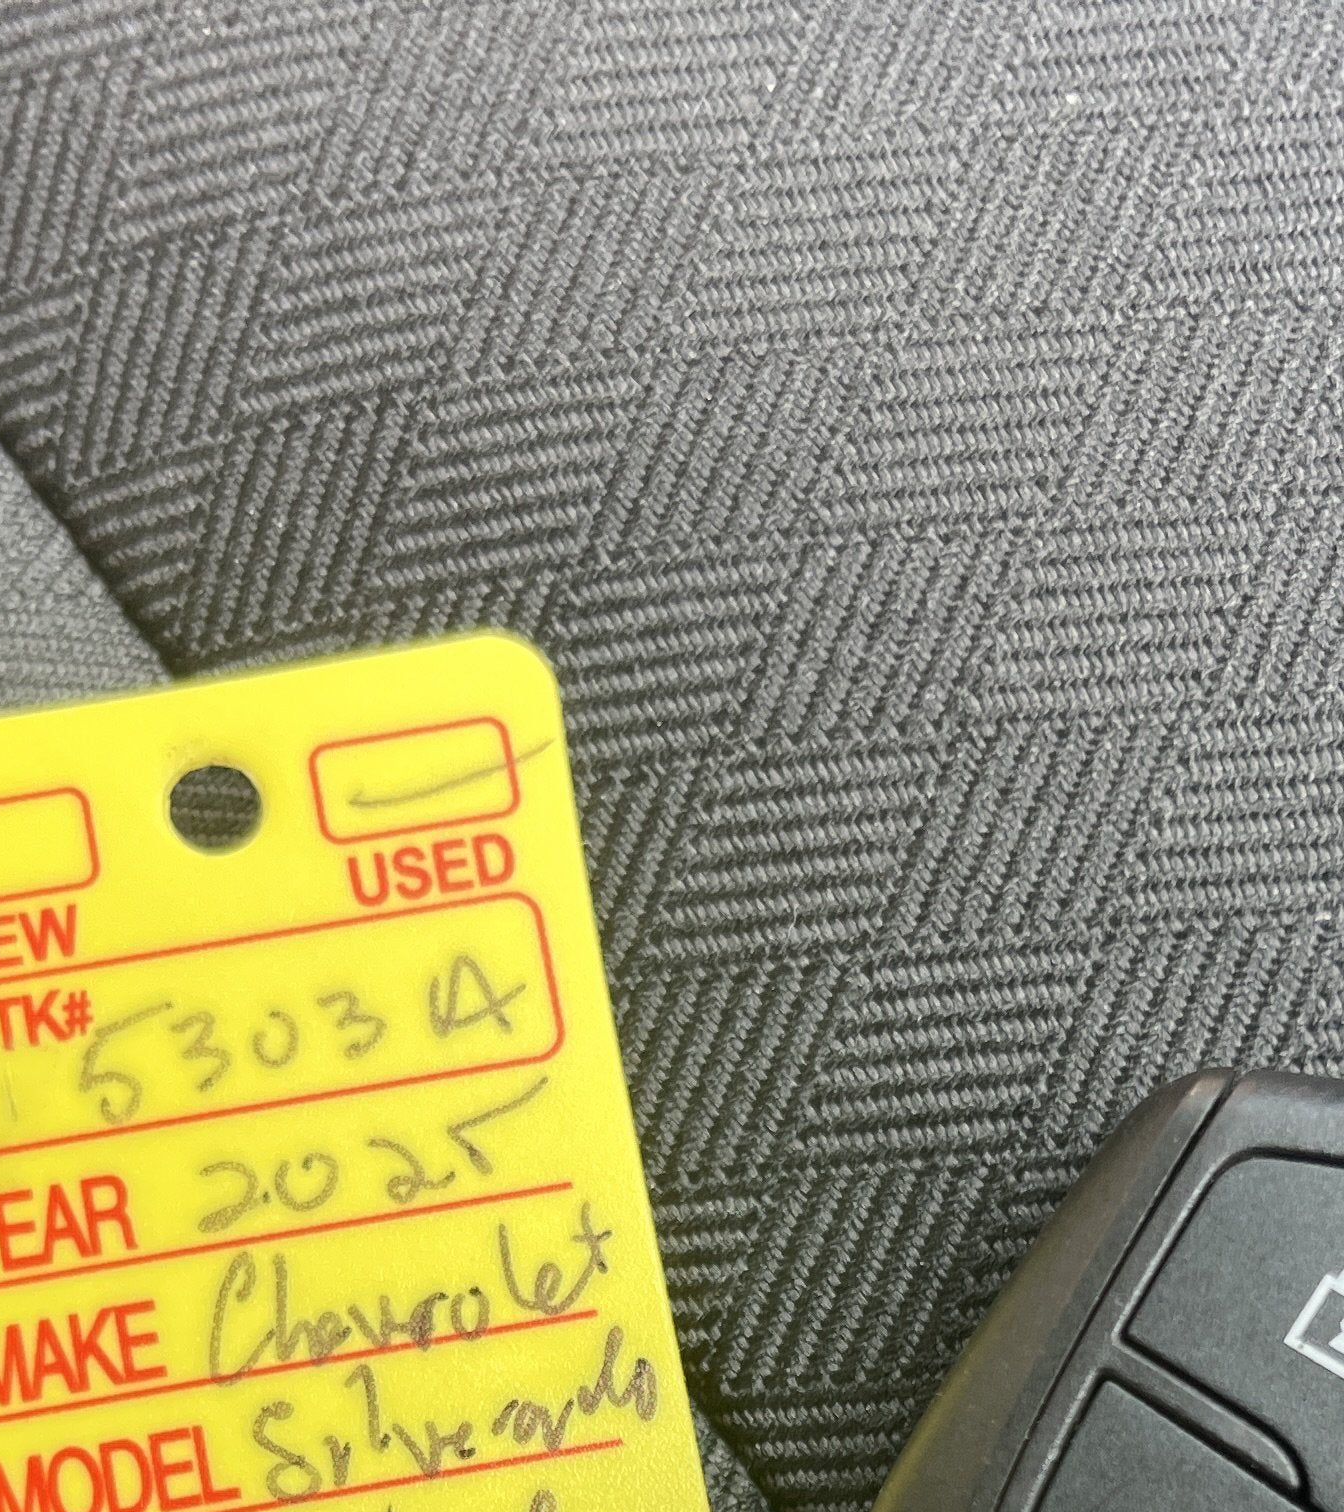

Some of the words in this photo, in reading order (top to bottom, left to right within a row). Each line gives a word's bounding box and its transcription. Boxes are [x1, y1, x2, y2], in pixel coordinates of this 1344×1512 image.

[346, 833, 517, 908] USED
[197, 1076, 549, 1233] 2025
[207, 1200, 613, 1386] Chevrolet
